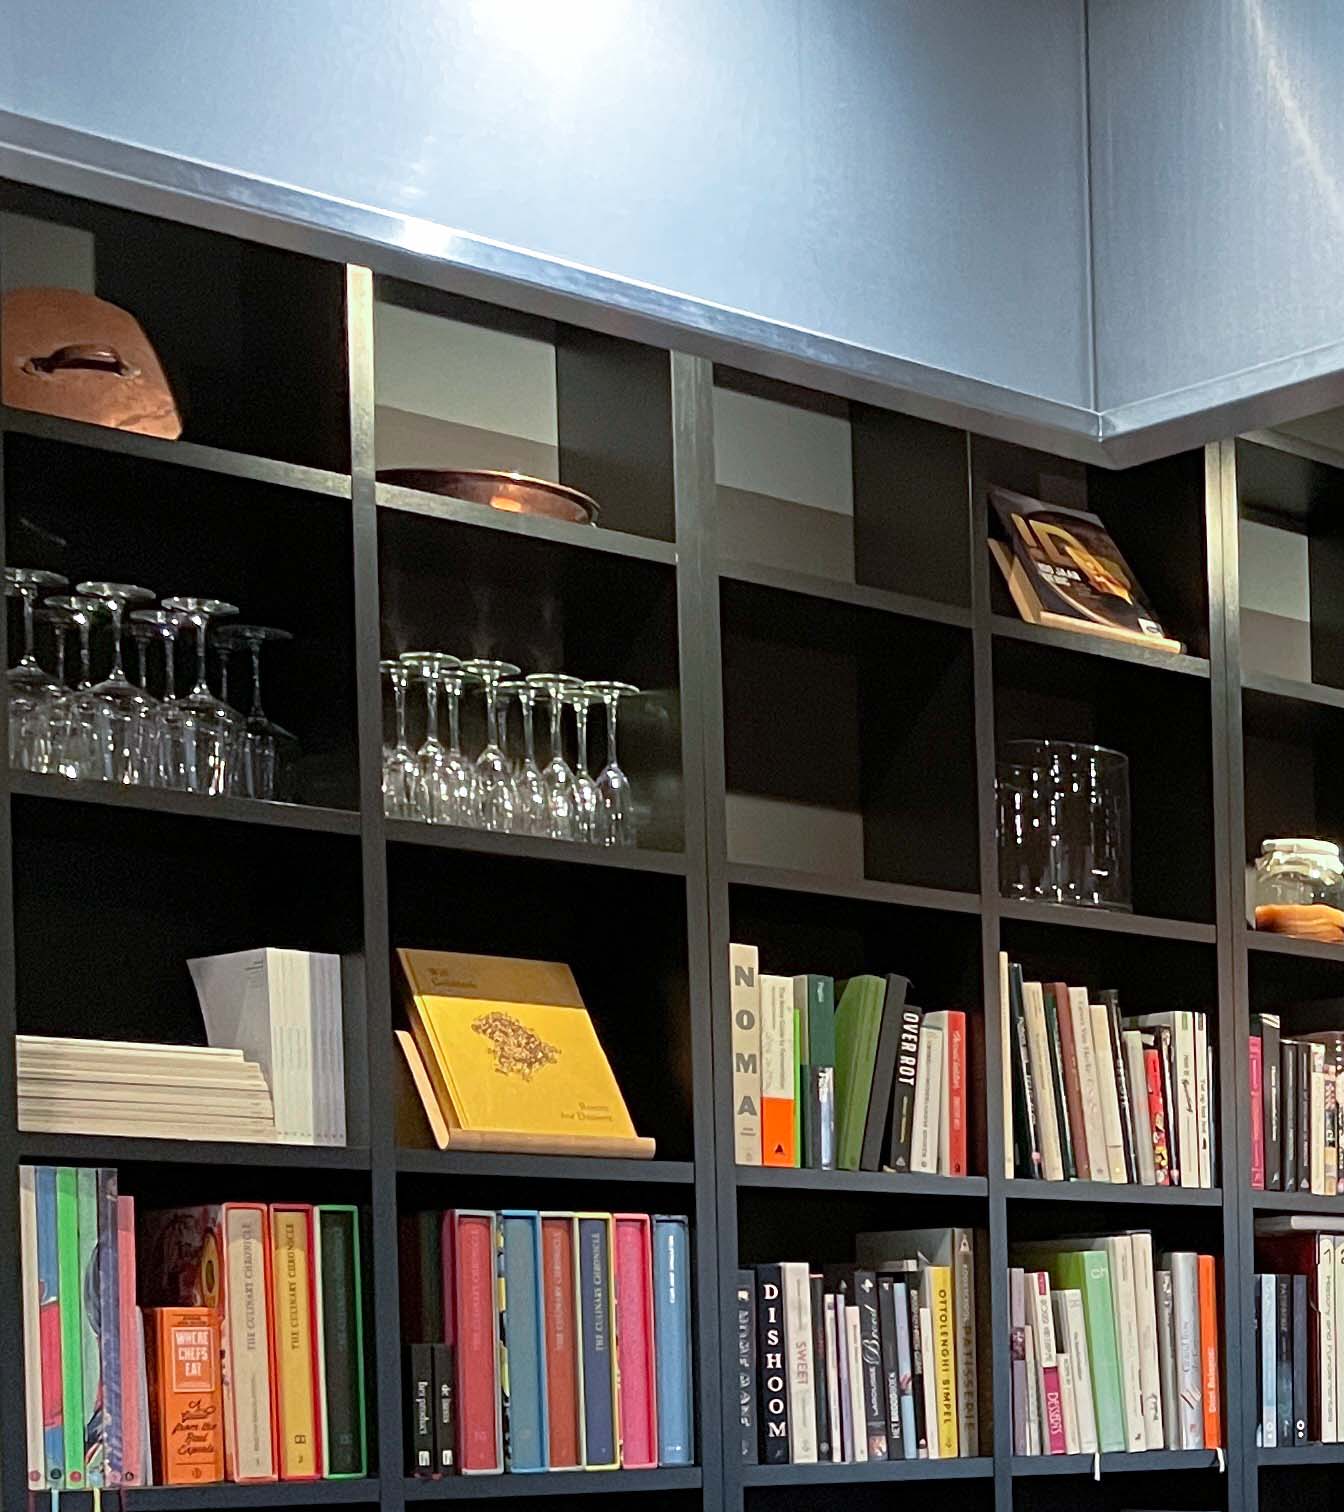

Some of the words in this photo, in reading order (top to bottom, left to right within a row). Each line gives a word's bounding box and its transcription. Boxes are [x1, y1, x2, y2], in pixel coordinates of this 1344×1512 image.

[734, 967, 758, 1117] NOMA
[901, 1010, 919, 1054] OVER
[898, 1054, 917, 1087] ROT
[1323, 1249, 1332, 1265] 1
[176, 1330, 209, 1346] WHERE
[938, 1288, 950, 1372] OTTOLENGHI
[177, 1347, 209, 1361] CHEFS
[184, 1362, 202, 1377] EAT
[764, 1283, 787, 1438] DISHOOM
[795, 1340, 809, 1385] SWEET
[942, 1378, 952, 1426] SIMPEL
[1047, 1391, 1063, 1435] DESSERTS
